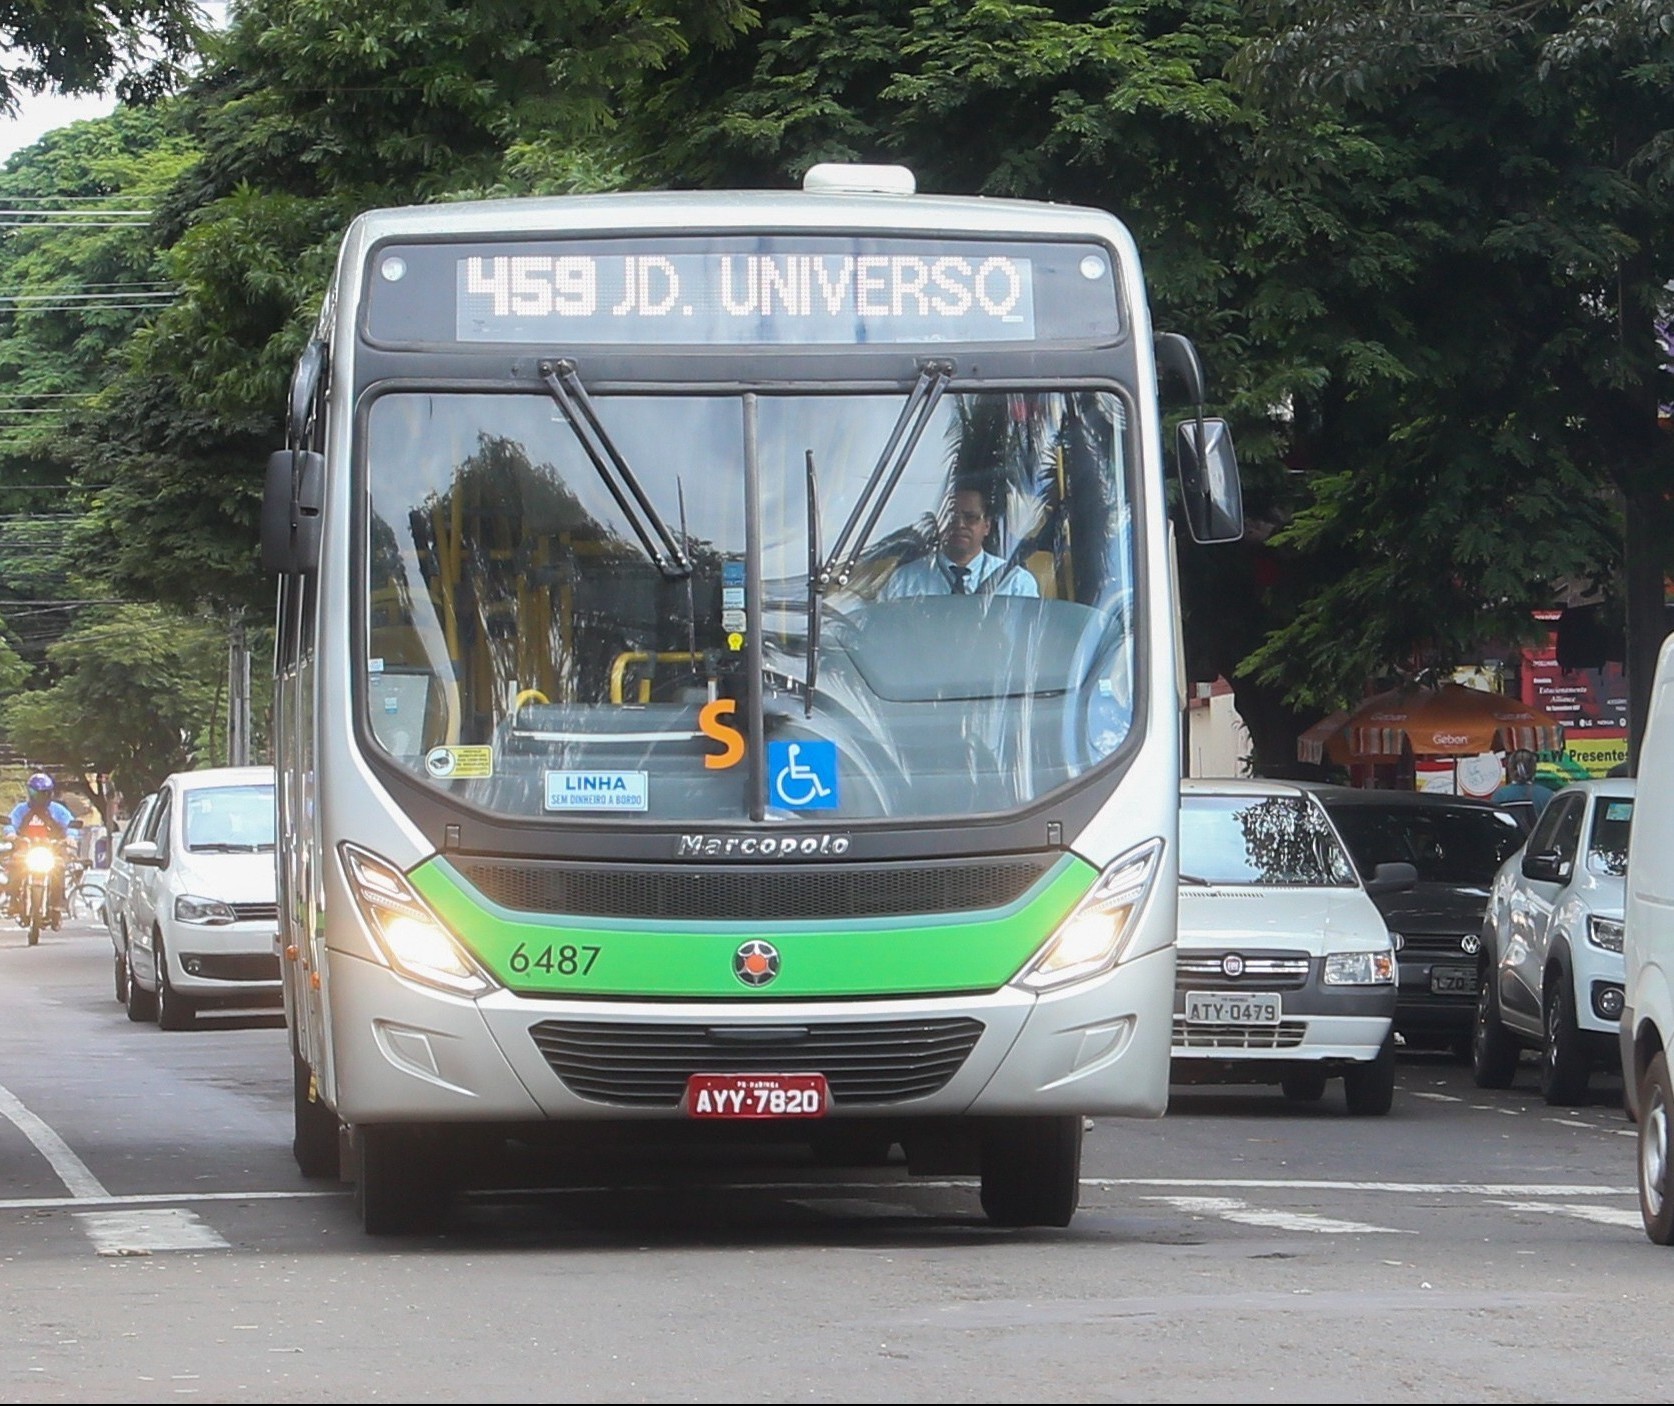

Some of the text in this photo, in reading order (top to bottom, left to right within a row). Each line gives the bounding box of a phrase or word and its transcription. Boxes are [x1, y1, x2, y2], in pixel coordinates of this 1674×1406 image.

[467, 256, 1021, 317] 459 JD. UNIVERSO
[698, 699, 745, 770] S
[565, 776, 626, 790] LINHA
[551, 794, 641, 805] SEM DINHEIRO A BORDO
[677, 834, 849, 858] Marcopolo
[509, 942, 602, 976] 6487
